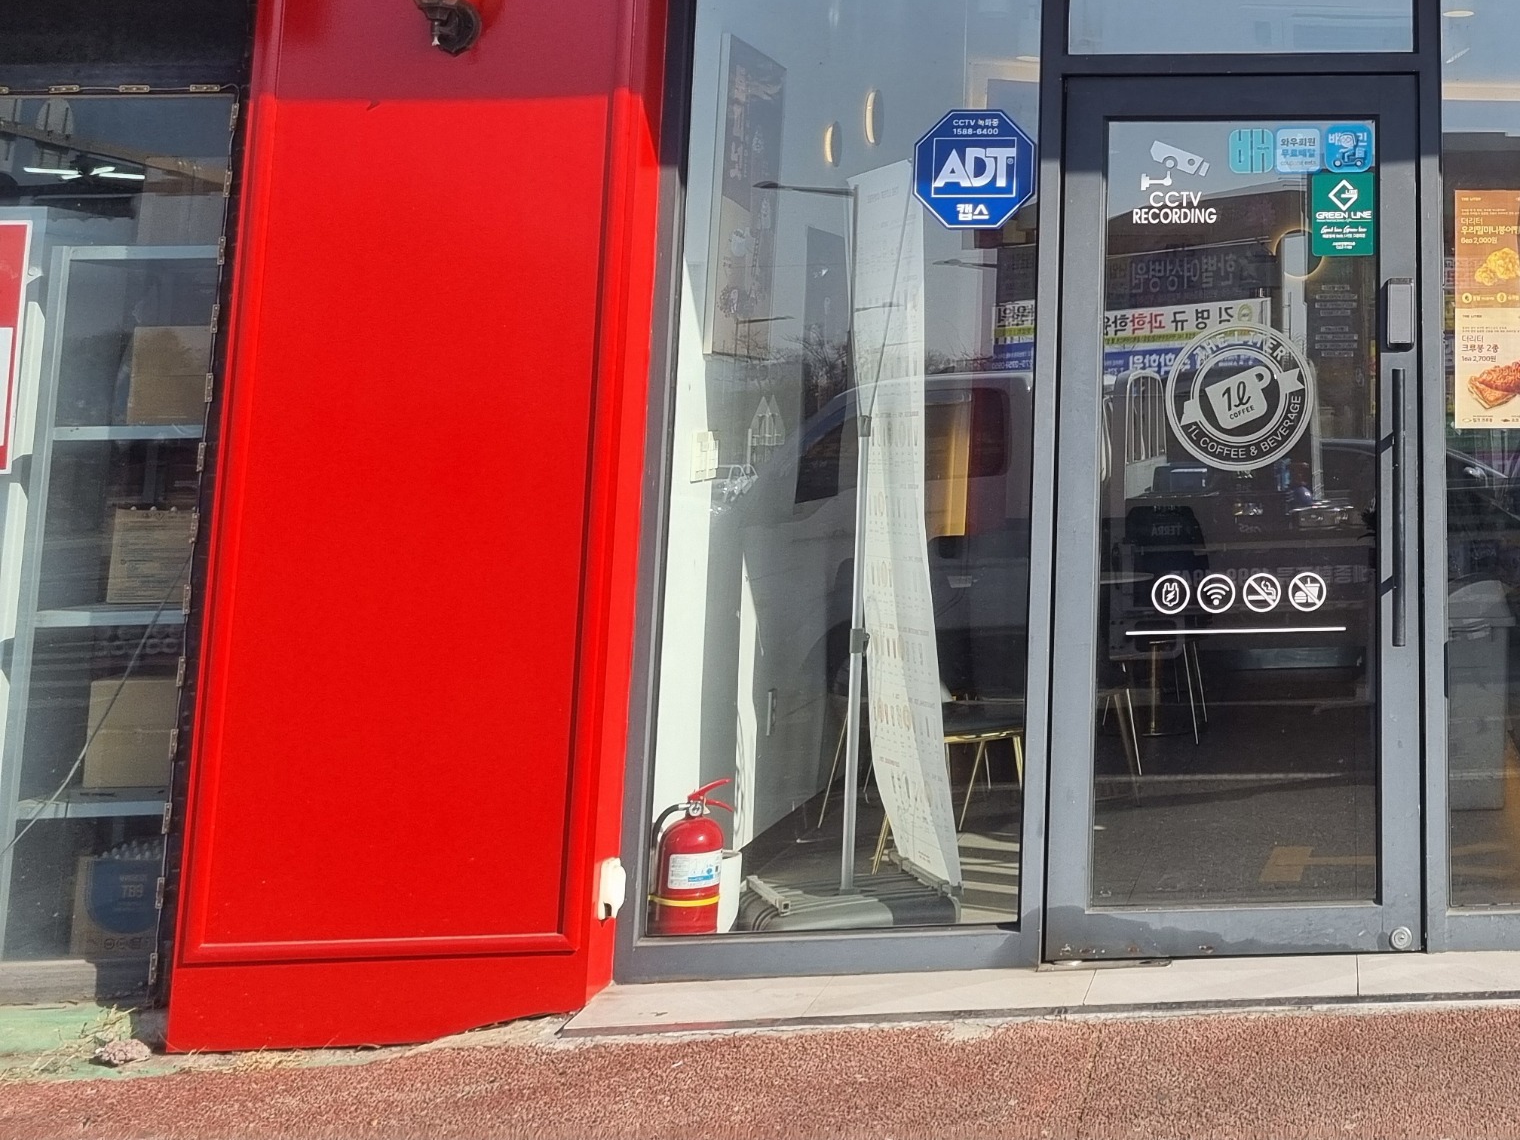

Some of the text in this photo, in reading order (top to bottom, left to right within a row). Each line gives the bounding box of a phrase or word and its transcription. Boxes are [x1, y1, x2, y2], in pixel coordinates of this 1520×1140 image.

[932, 147, 1017, 187] ADT
[1149, 191, 1202, 207] CCTV
[956, 204, 990, 221] 캡스
[1132, 207, 1217, 224] RECORDING
[1316, 210, 1372, 219] GREEN LINE
[1461, 217, 1483, 225] 더리터
[1193, 331, 1287, 361] THE LITER
[1472, 355, 1497, 363] 2,700원
[1229, 404, 1255, 420] COFFEE
[1199, 437, 1247, 459] COFFEE
[1249, 445, 1258, 457] &
[1260, 395, 1302, 453] BEVERAGE
